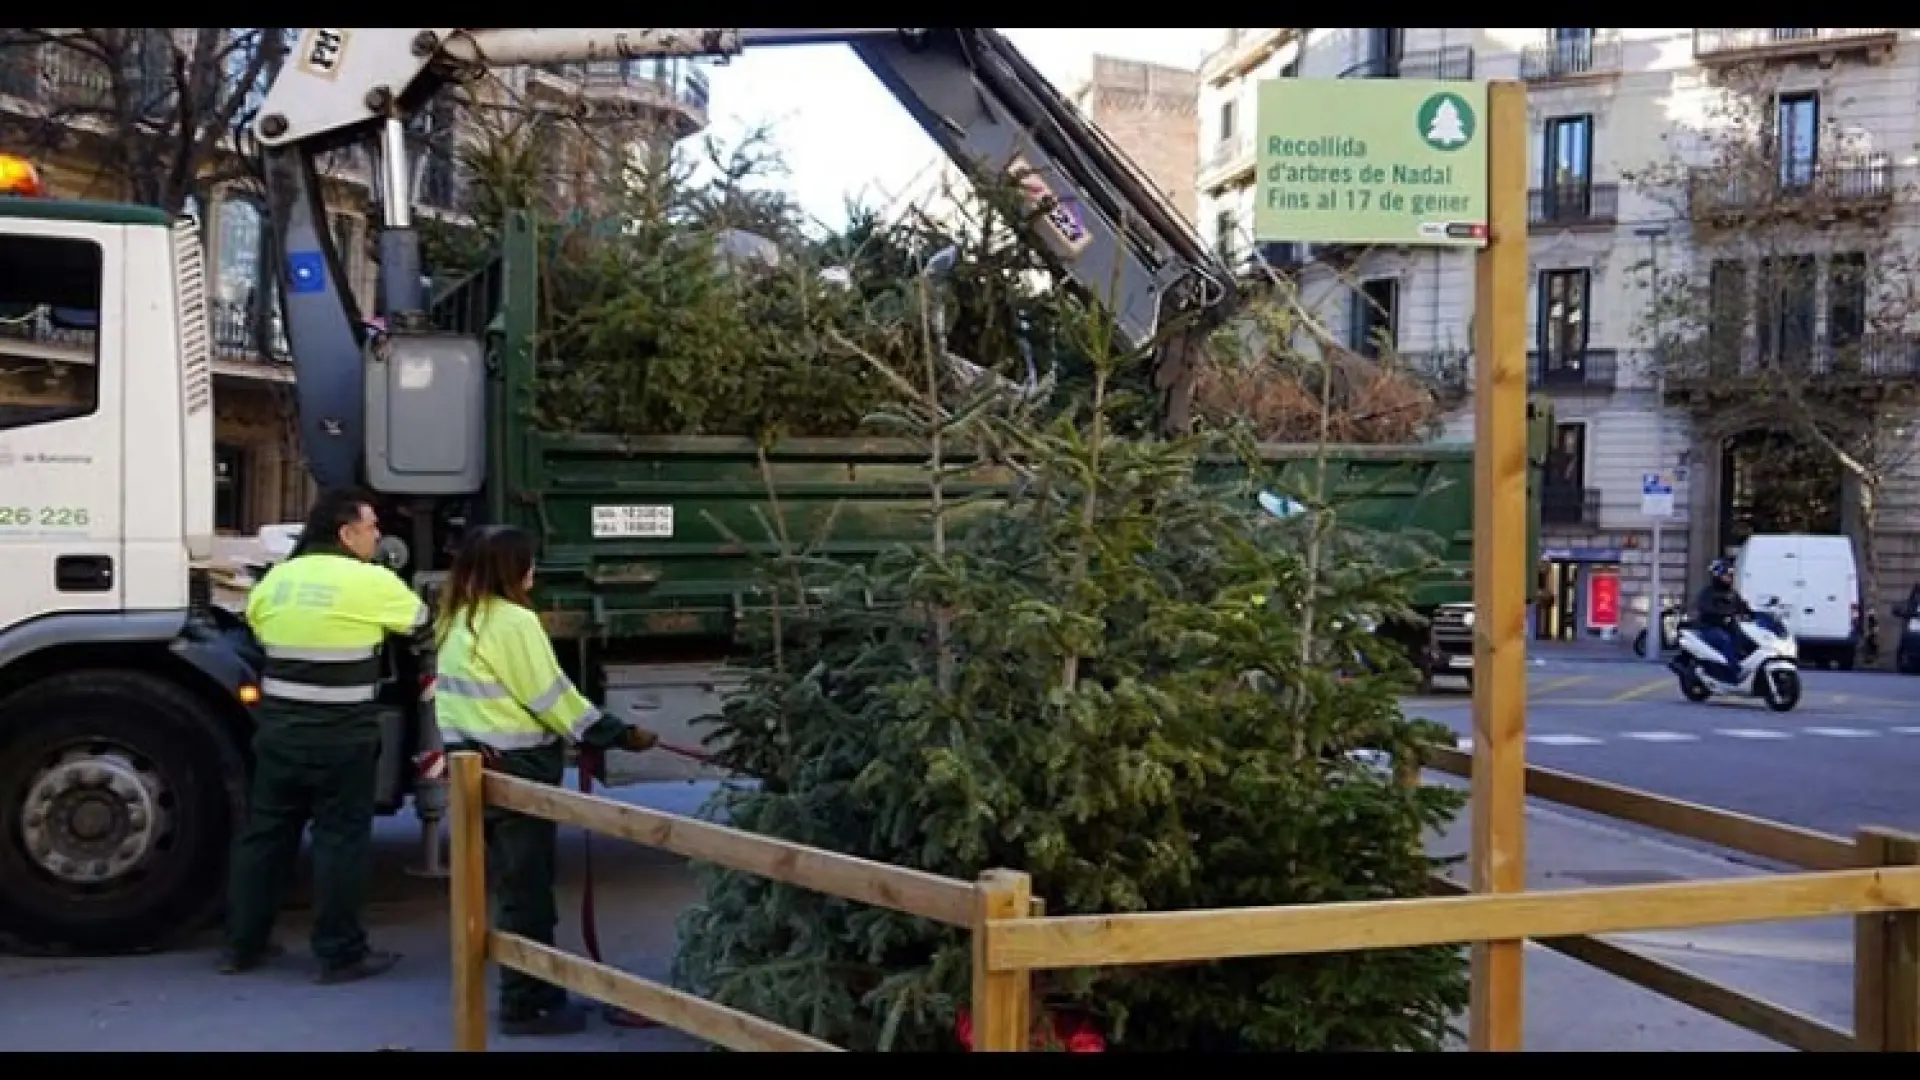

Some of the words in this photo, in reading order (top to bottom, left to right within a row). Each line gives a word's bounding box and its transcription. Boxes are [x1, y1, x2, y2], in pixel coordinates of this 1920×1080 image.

[1267, 135, 1368, 157] Recollida
[1267, 162, 1352, 183] d'arbres
[1359, 164, 1386, 184] de
[1392, 164, 1452, 185] Nadal
[1267, 187, 1309, 210] Fins
[1316, 189, 1337, 211] al
[1346, 189, 1372, 211] 17
[1380, 190, 1404, 211] de
[1411, 193, 1470, 216] gener
[40, 506, 90, 525] 226
